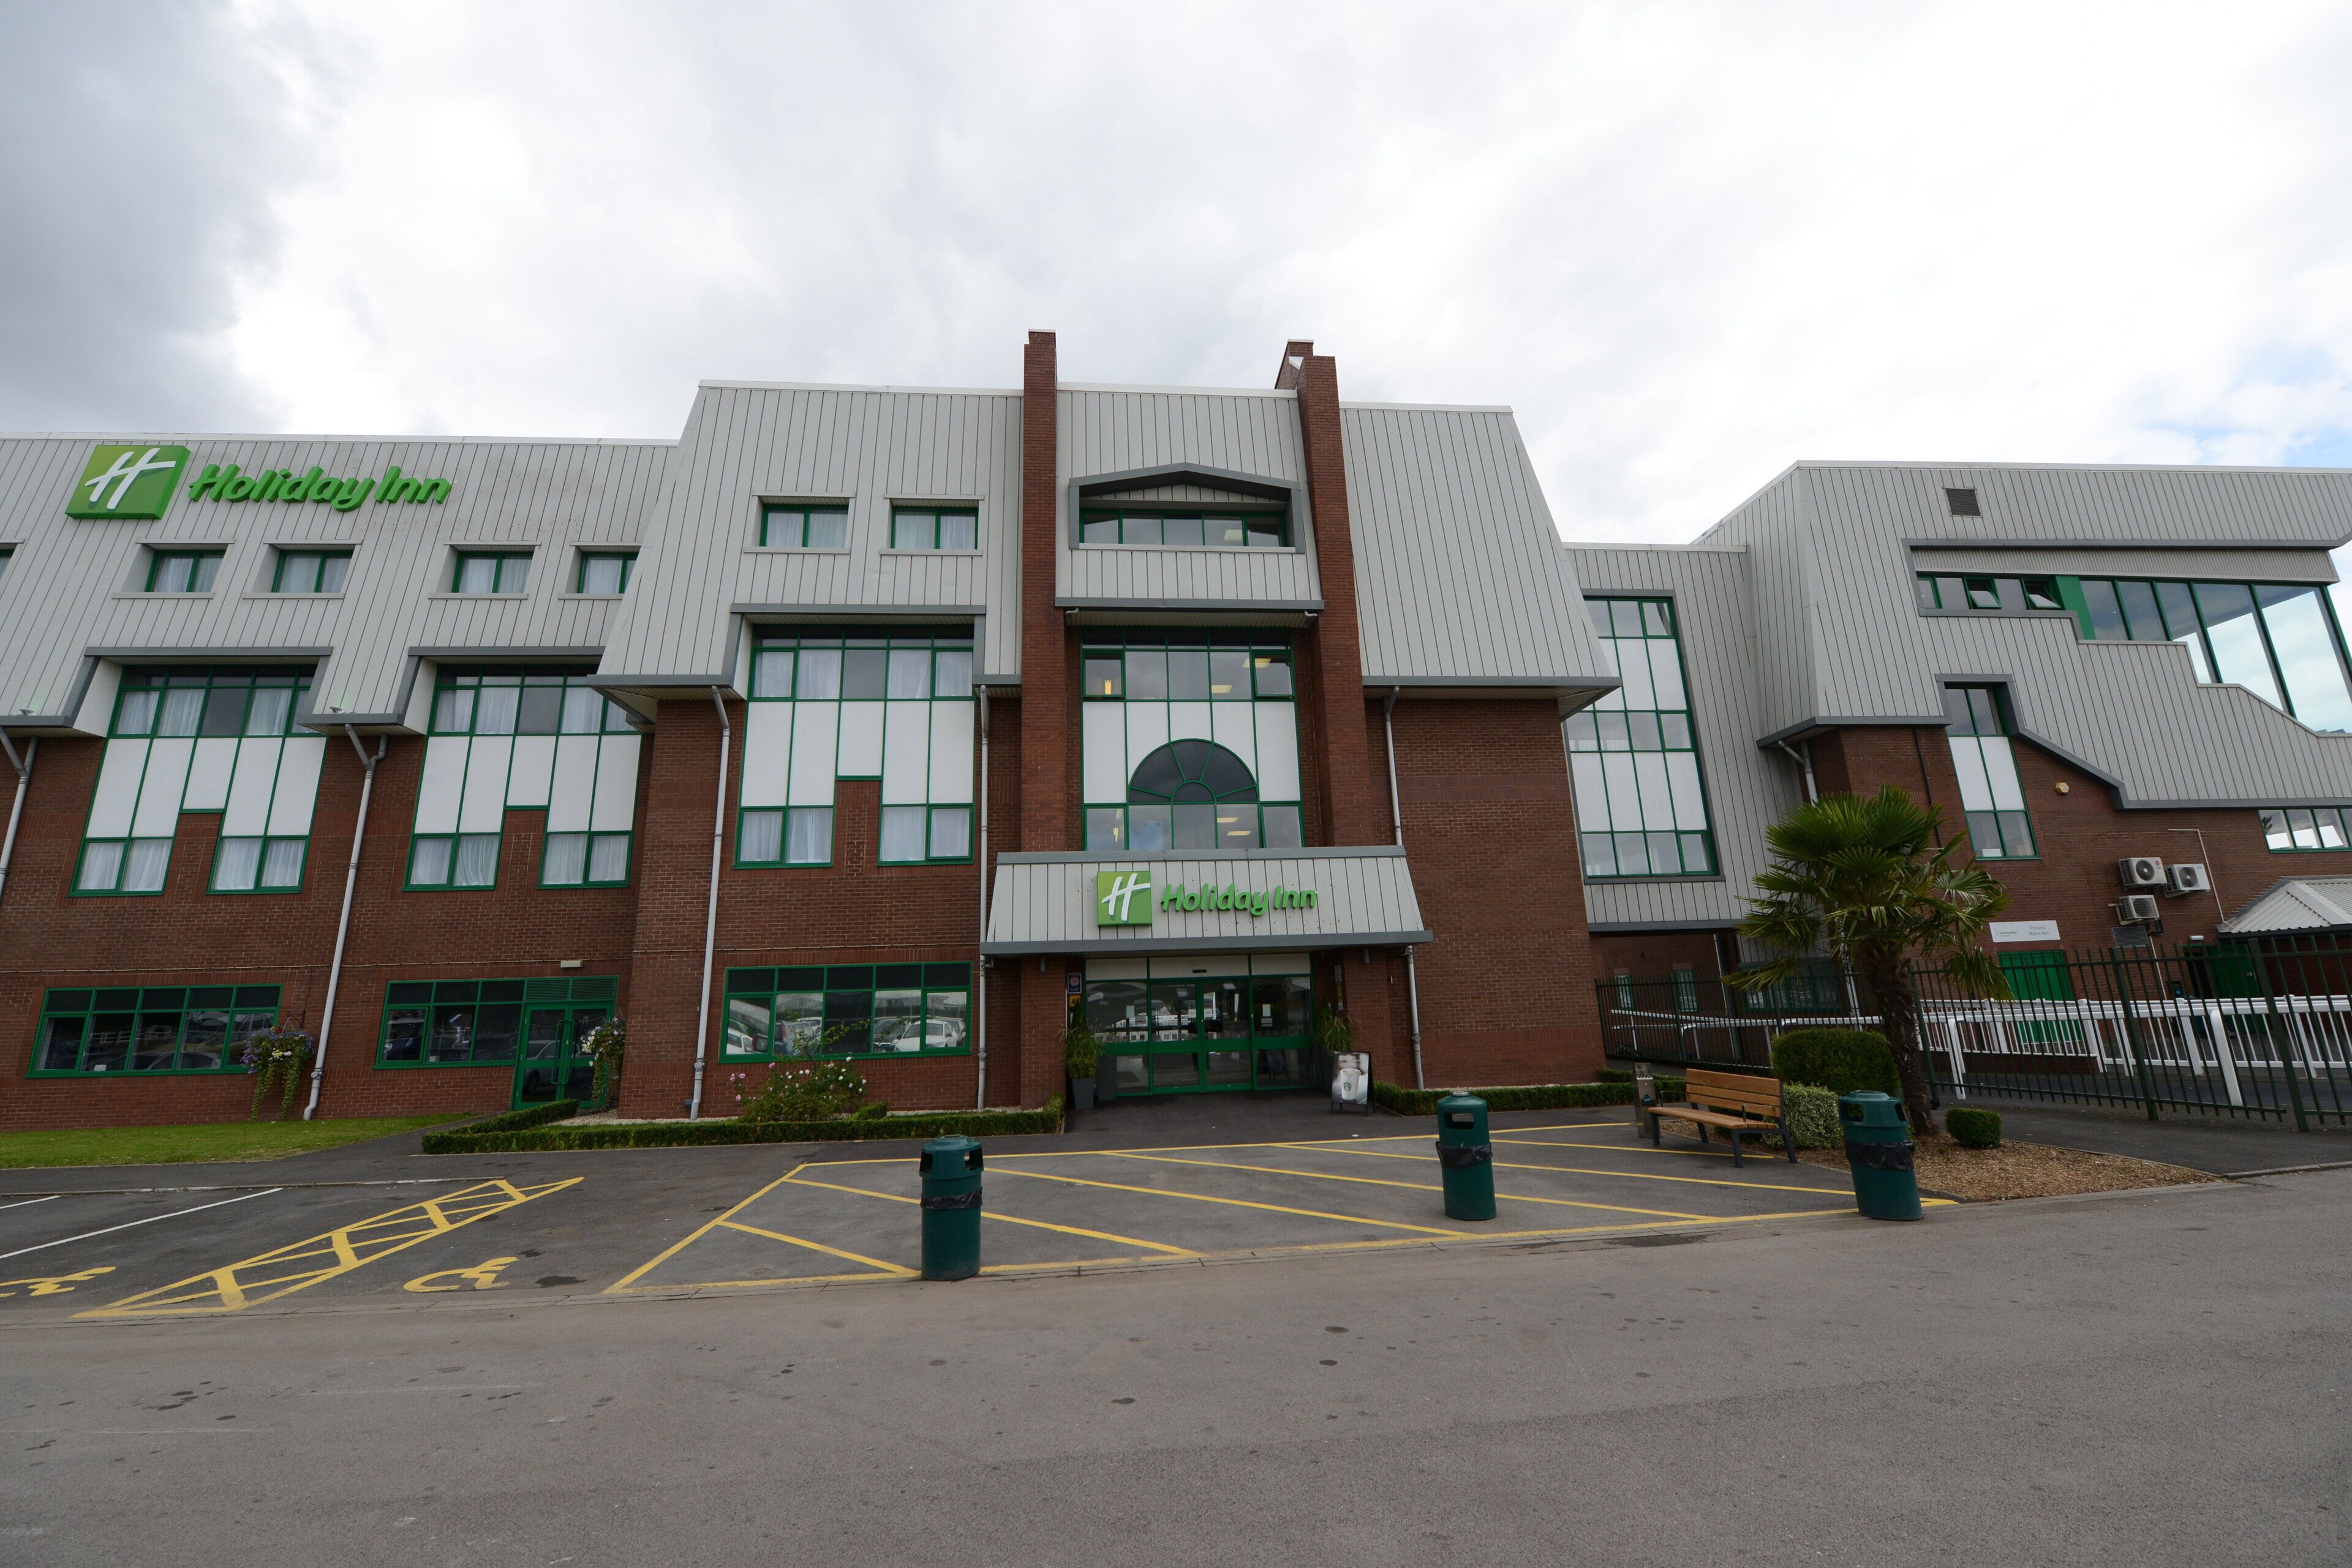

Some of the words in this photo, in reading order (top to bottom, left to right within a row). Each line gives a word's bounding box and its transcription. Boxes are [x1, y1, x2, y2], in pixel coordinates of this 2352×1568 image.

[187, 464, 375, 512] Holiday
[375, 466, 452, 504] Inn
[1161, 883, 1270, 916] Holiday
[1274, 885, 1318, 910] Inn
